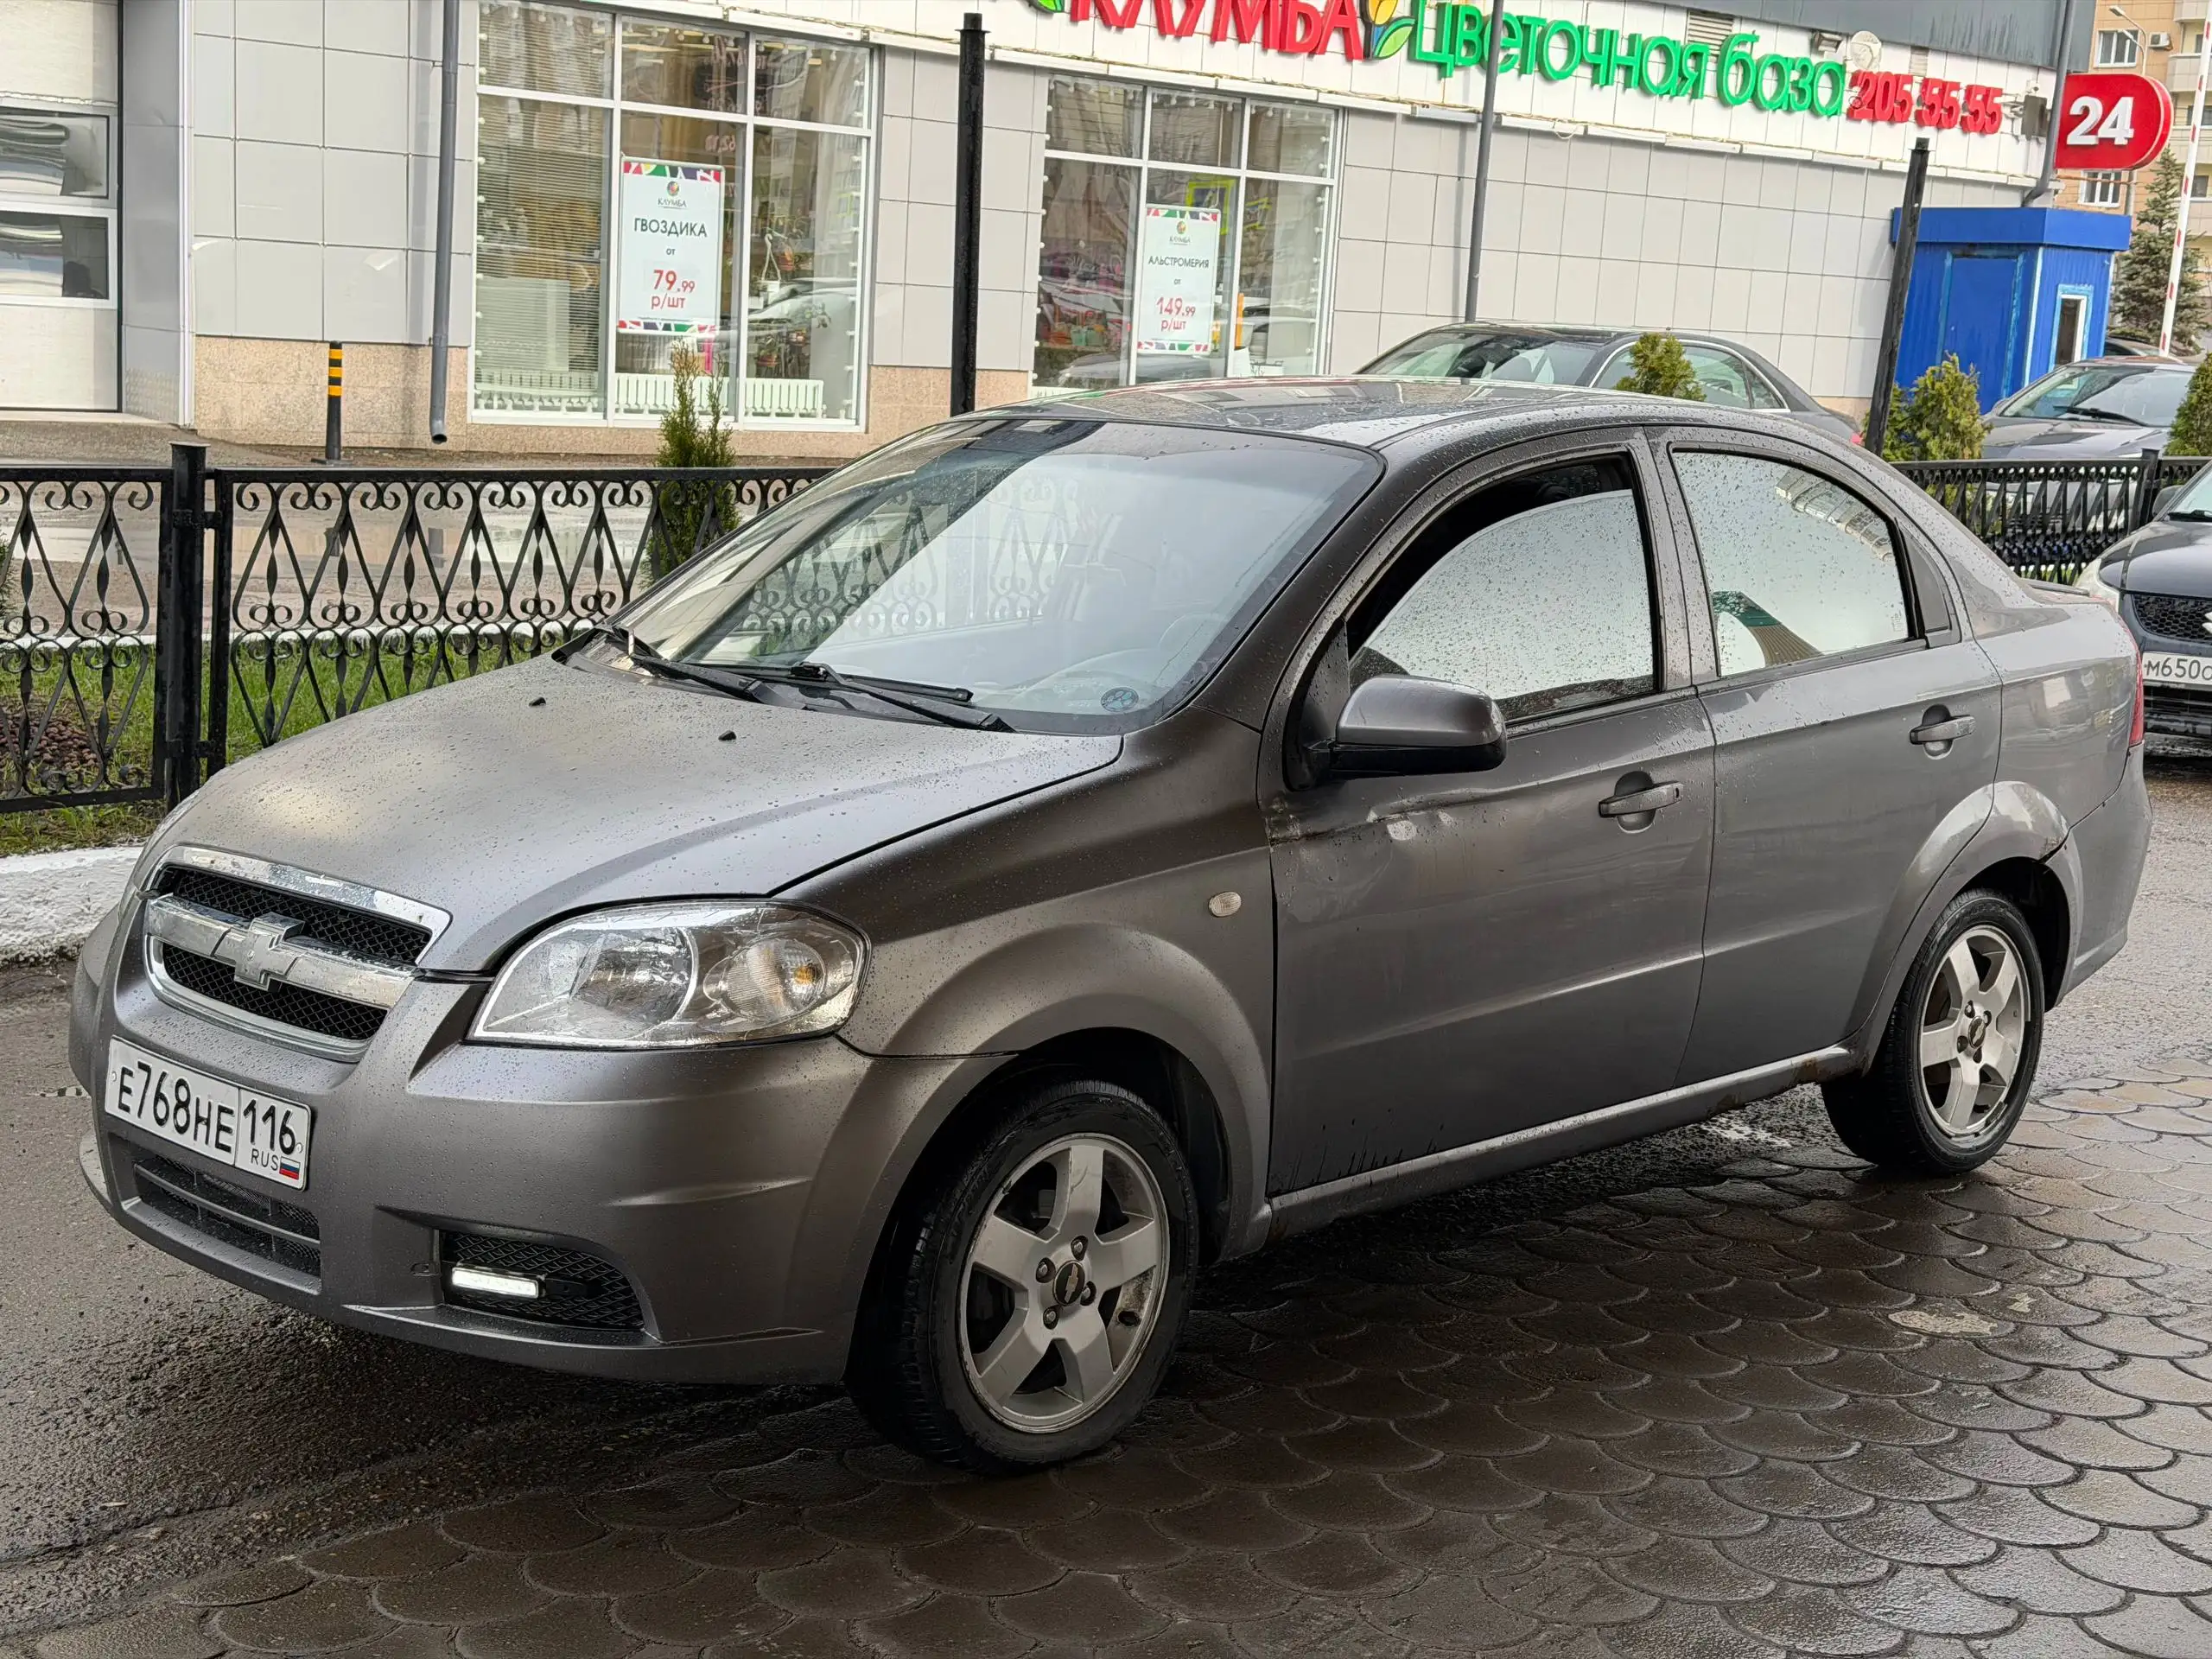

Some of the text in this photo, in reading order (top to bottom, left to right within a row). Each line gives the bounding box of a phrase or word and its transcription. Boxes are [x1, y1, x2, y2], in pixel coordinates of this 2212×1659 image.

[1716, 33, 1847, 117] база
[1847, 70, 2003, 135] 205 55 55
[2066, 95, 2135, 145] 24
[633, 218, 708, 238] ГВОЗДИКА
[1147, 256, 1210, 268] АЛЬСТРОМЕРИЯ
[653, 270, 696, 293] 79.99
[651, 294, 686, 309] р/шт
[1156, 296, 1197, 318] 149.99
[1160, 319, 1186, 333] р/шт
[118, 1060, 296, 1155] Е768НЕ 116
[251, 1149, 279, 1172] RUS
